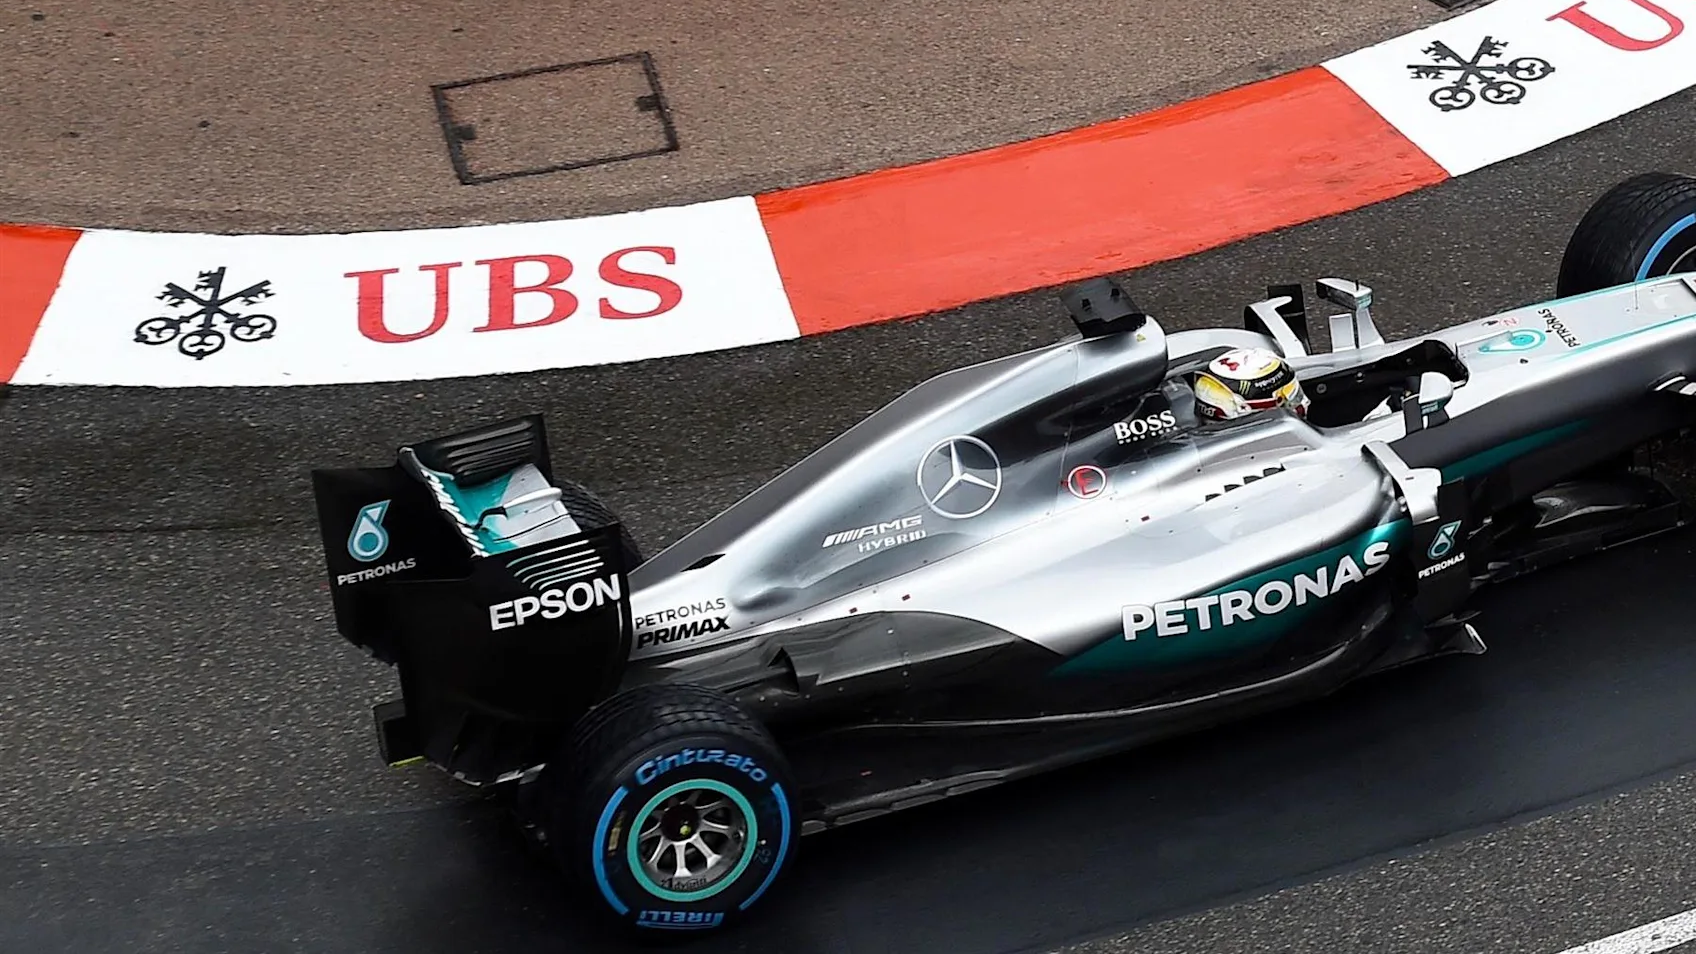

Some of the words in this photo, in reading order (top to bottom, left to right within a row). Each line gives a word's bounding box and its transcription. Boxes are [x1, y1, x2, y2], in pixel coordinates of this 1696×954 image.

[344, 246, 684, 344] UBS
[1537, 307, 1581, 349] PETRONAS
[1113, 410, 1176, 440] BOSS
[858, 529, 927, 553] HYBRID
[336, 557, 417, 586] PETRONAS
[1418, 551, 1466, 580] PETRONAS
[489, 573, 621, 632] EPSON
[1120, 541, 1391, 641] PETRONAS
[635, 598, 727, 630] PETRONAS
[636, 616, 731, 650] PRIMAX
[636, 910, 725, 930] PIRELLI
